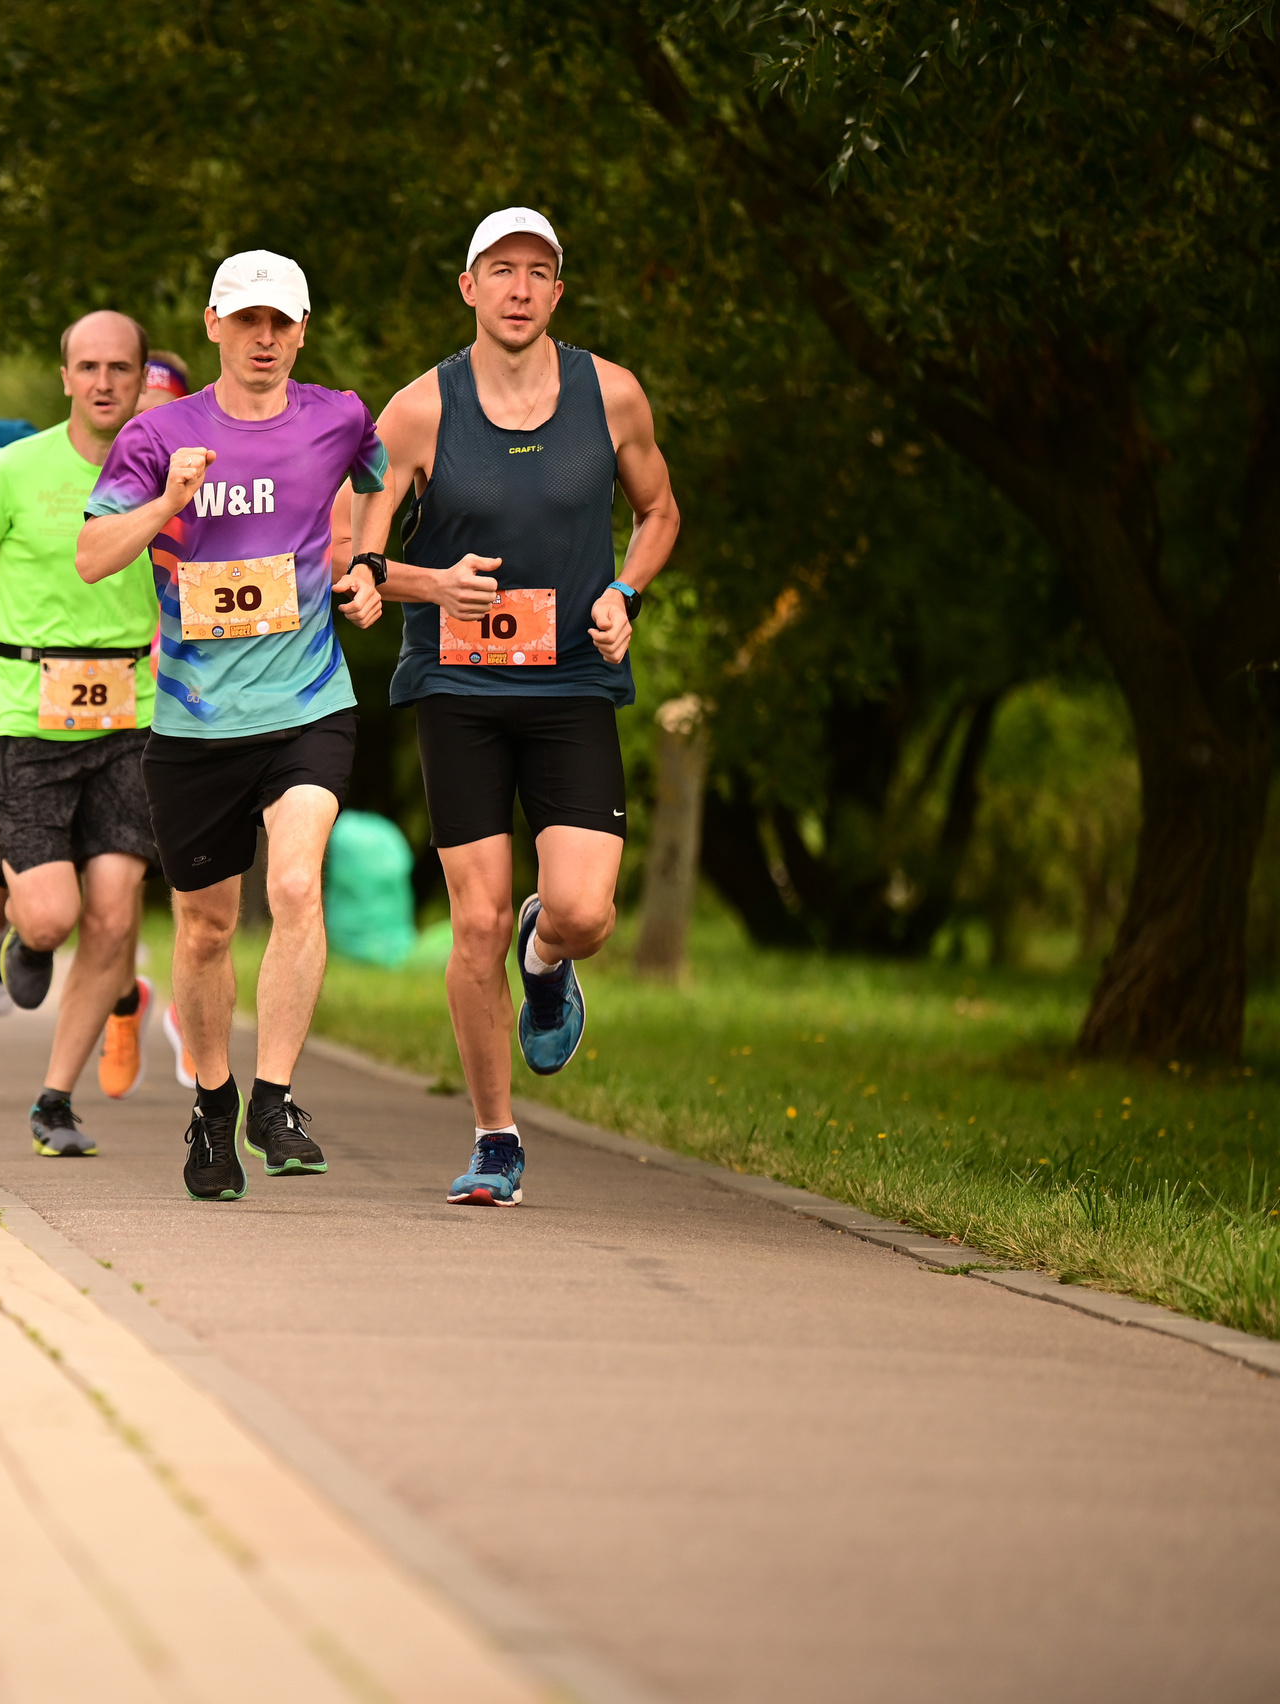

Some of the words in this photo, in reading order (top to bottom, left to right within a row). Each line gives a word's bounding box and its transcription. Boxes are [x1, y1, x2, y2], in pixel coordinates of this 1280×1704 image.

[509, 445, 536, 454] CRAFT
[193, 478, 275, 518] W&R
[214, 585, 262, 613] 30
[477, 613, 517, 639] 10
[71, 684, 107, 706] 28
